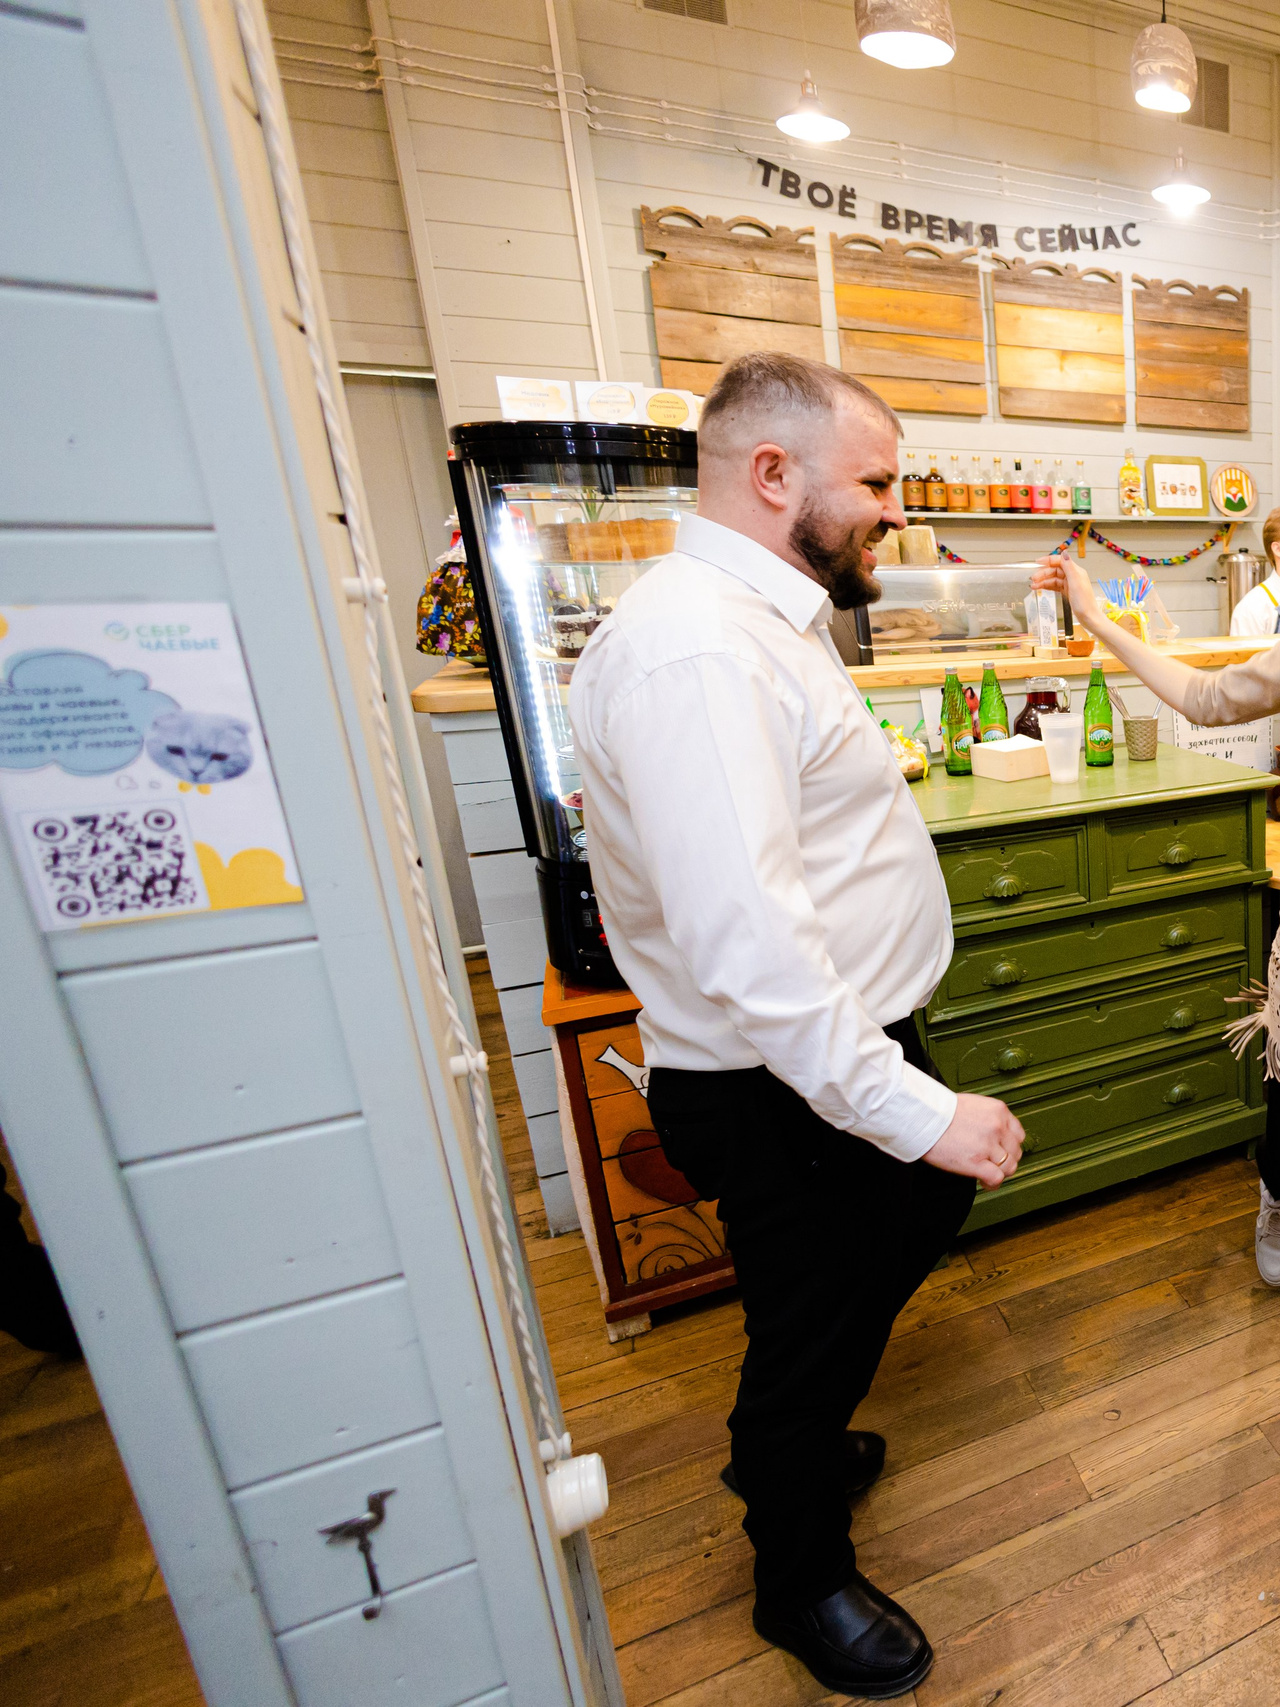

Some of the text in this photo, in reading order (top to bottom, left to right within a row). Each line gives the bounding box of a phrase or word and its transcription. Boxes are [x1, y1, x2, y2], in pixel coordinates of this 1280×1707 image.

[757, 157, 1141, 253] ТВОЁ ВРЕМЯ СЕЙЧАС
[136, 623, 191, 637] СБЕР
[138, 637, 220, 651] ЧАЕВЫЕ
